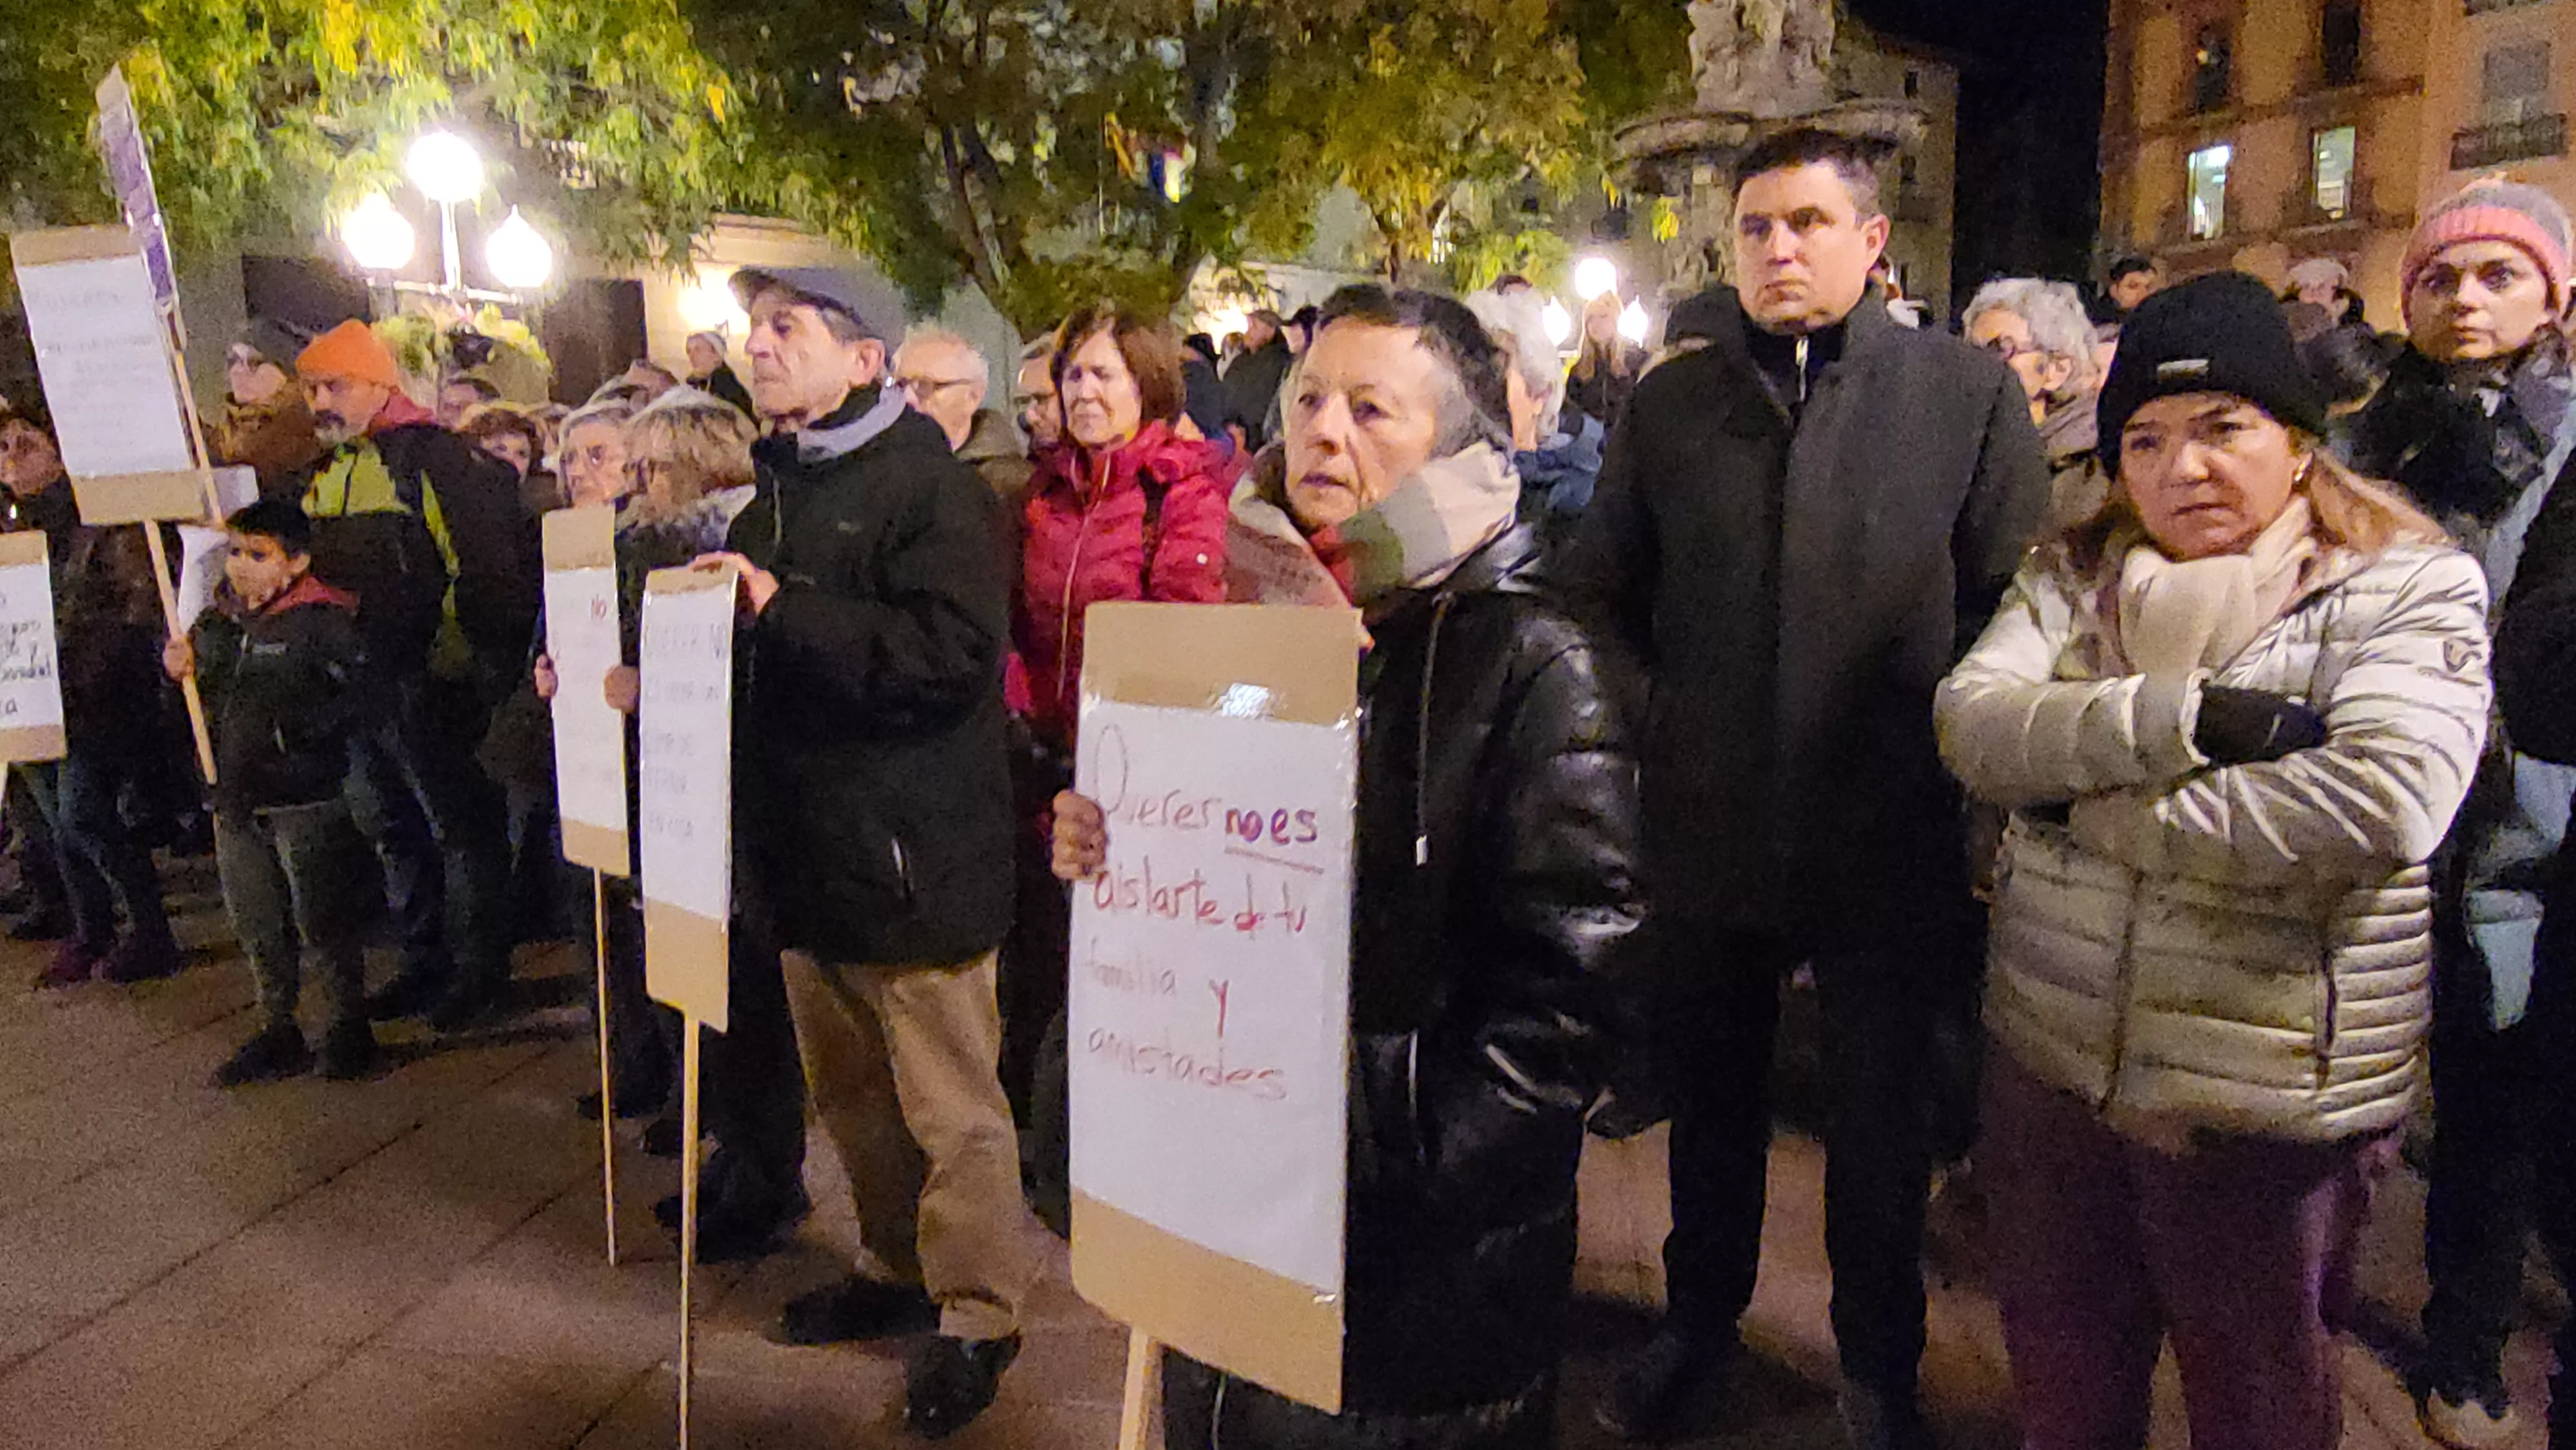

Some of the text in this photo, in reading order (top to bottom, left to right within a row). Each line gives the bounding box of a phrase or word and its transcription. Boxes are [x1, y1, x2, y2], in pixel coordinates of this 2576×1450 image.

[1095, 855, 1226, 926] aislarte
[1274, 882, 1307, 933] tu
[1088, 1027, 1287, 1100] amistades
